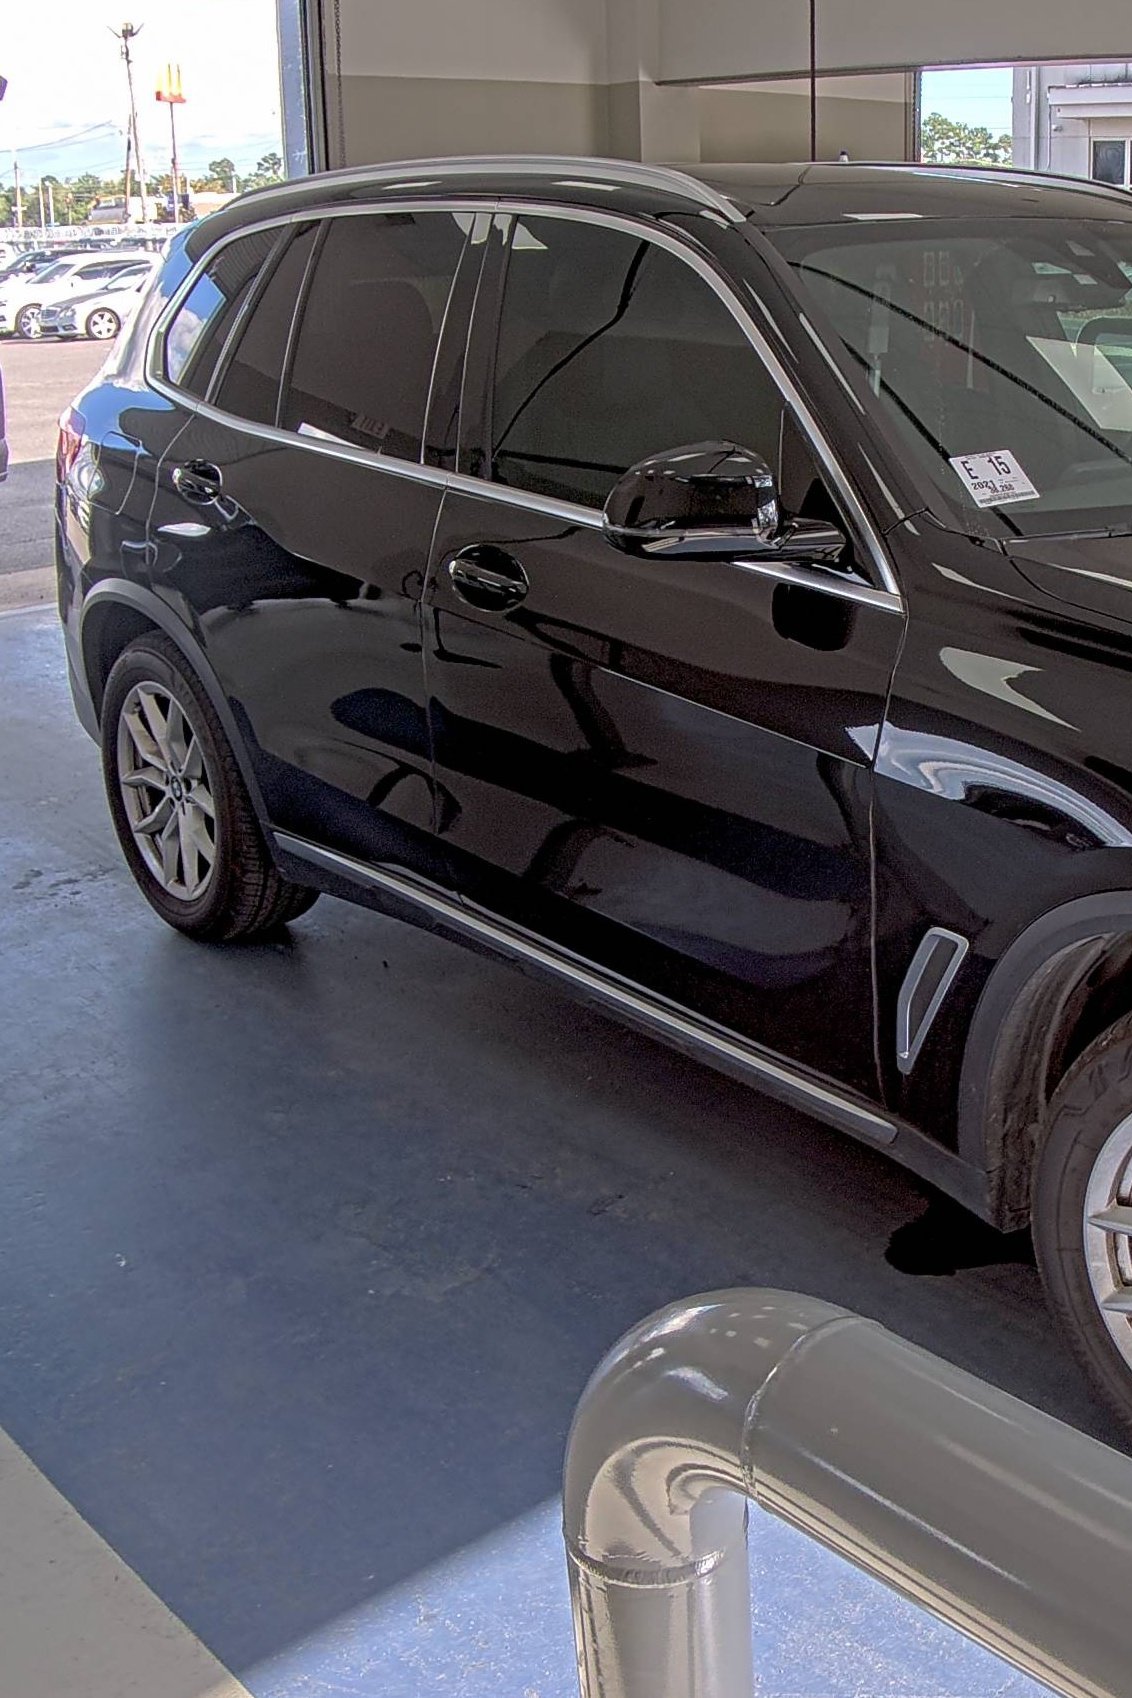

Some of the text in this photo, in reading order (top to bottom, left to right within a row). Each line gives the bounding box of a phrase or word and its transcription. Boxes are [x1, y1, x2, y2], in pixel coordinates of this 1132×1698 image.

[961, 455, 1011, 480] E 15
[971, 480, 996, 491] 2021
